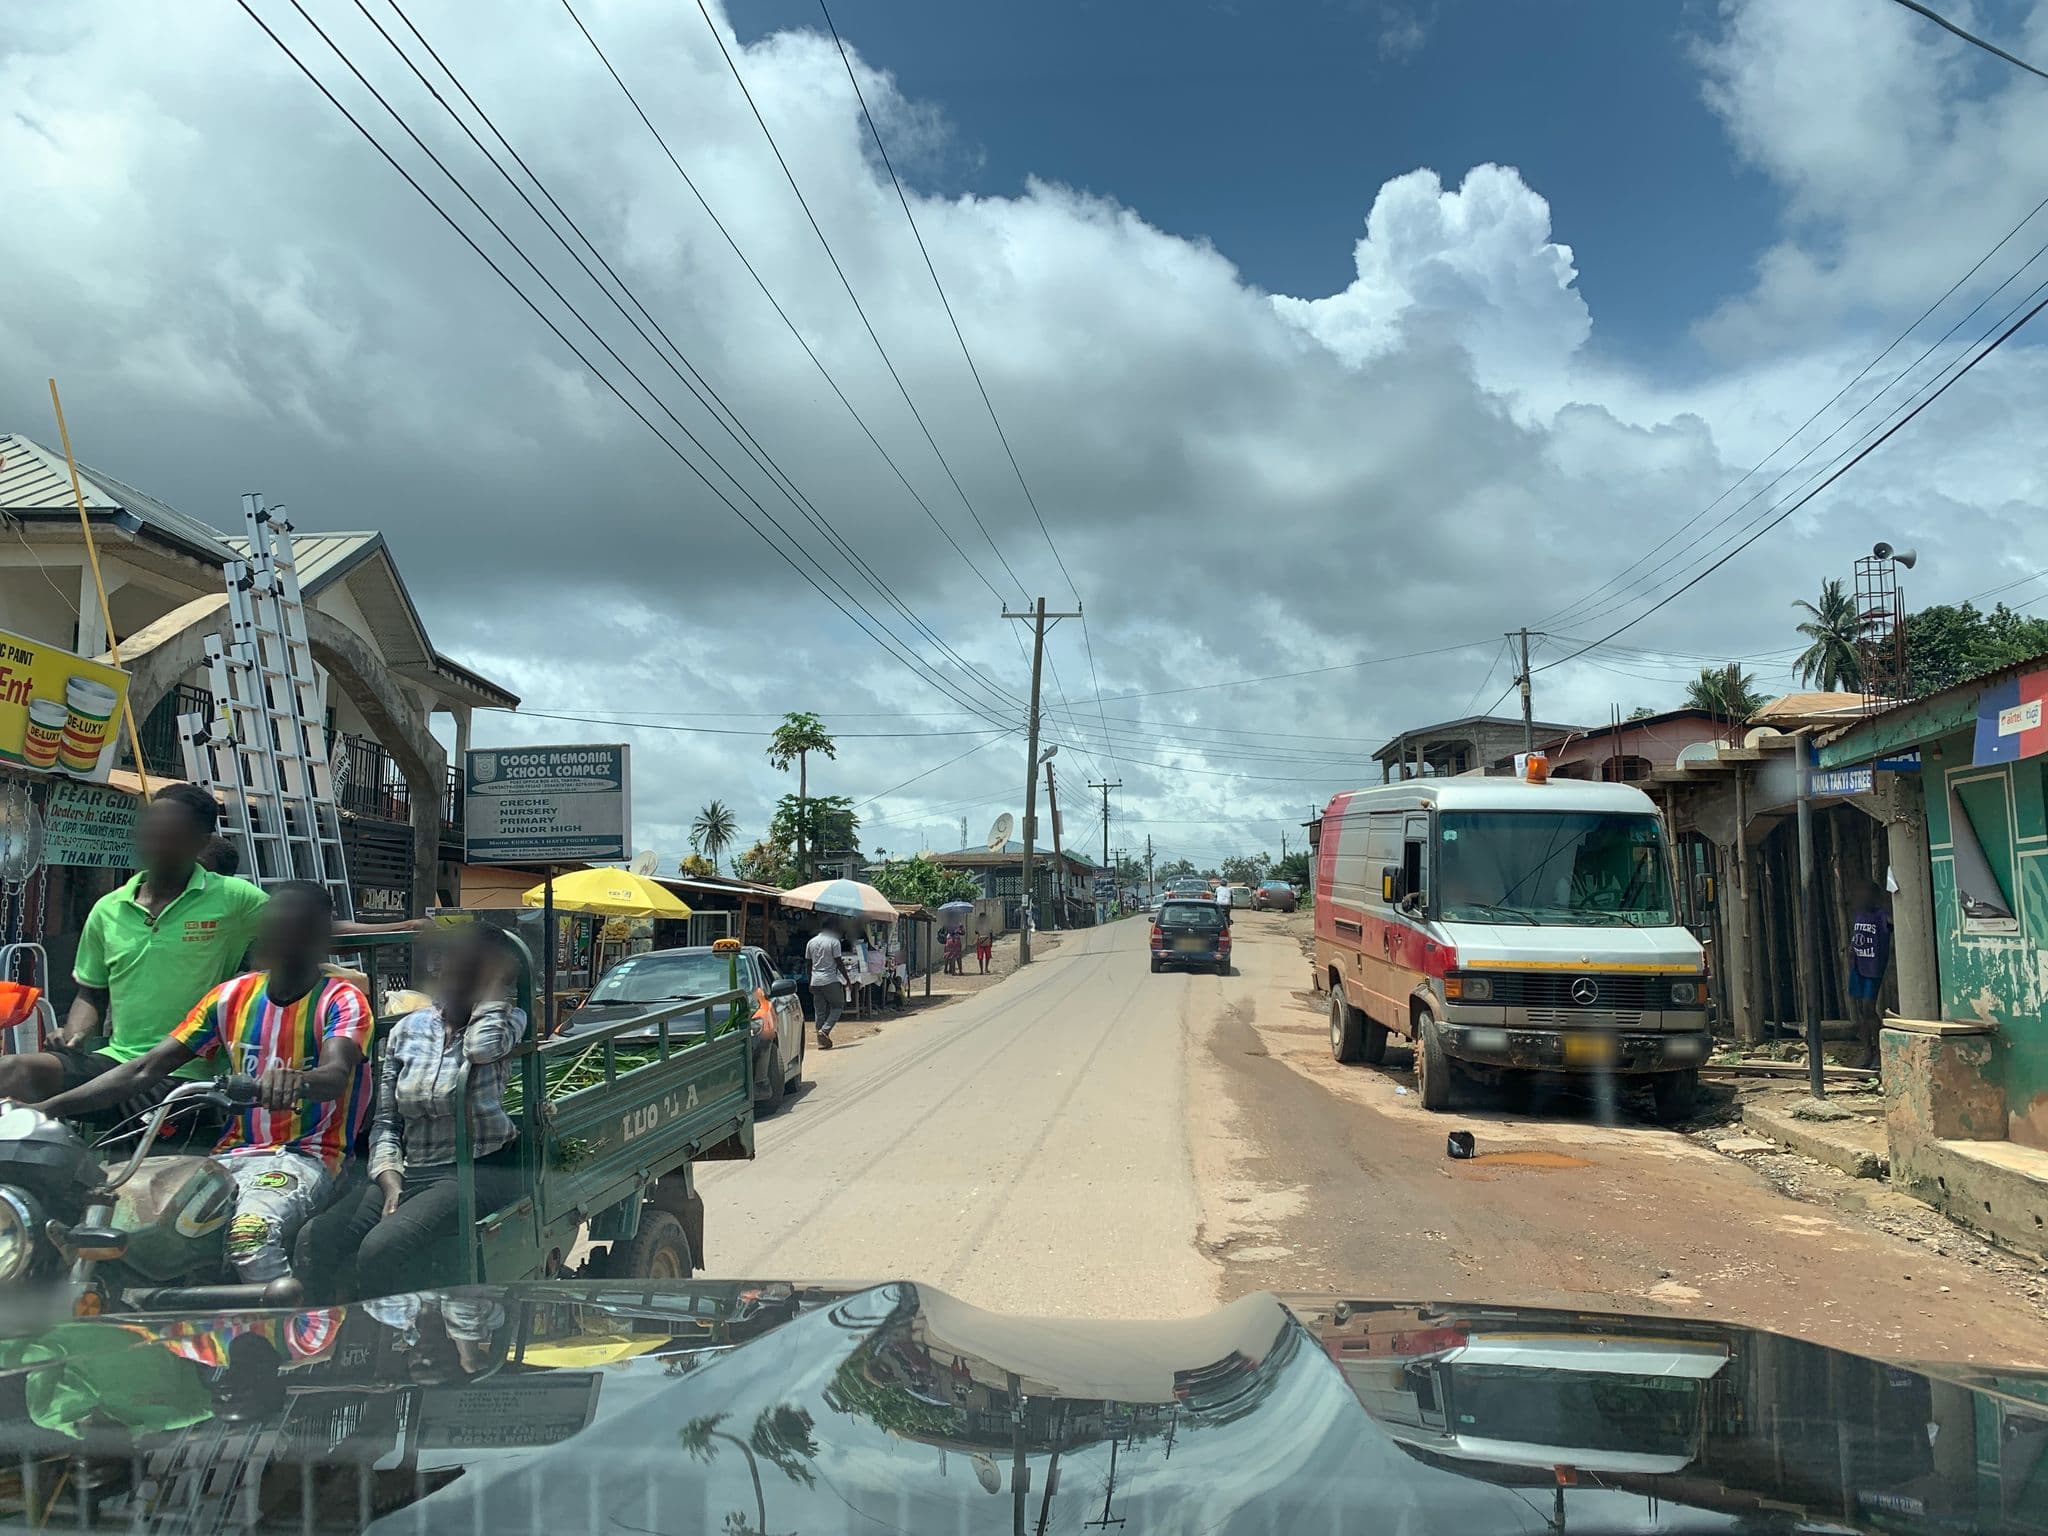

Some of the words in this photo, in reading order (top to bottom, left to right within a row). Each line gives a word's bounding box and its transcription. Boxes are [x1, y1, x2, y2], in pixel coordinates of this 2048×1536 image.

[8, 646, 35, 667] PAINT
[67, 714, 104, 735] DE-LUXY
[501, 754, 546, 766] GOGOE
[550, 751, 613, 765] MEMORIAL
[506, 766, 552, 778] SCHOOL
[556, 764, 611, 776] COMPLEX
[1812, 774, 1829, 792] NANA
[1830, 772, 1849, 791] TAKYI
[1850, 769, 1872, 789] STREE
[57, 784, 103, 806] FEAR
[500, 799, 549, 807] CRECHE
[500, 808, 558, 816] NURSERY
[500, 817, 556, 825] PRIMARY
[500, 826, 547, 834] JUNIOR
[551, 825, 582, 833] HIGH
[60, 849, 104, 865] THANK
